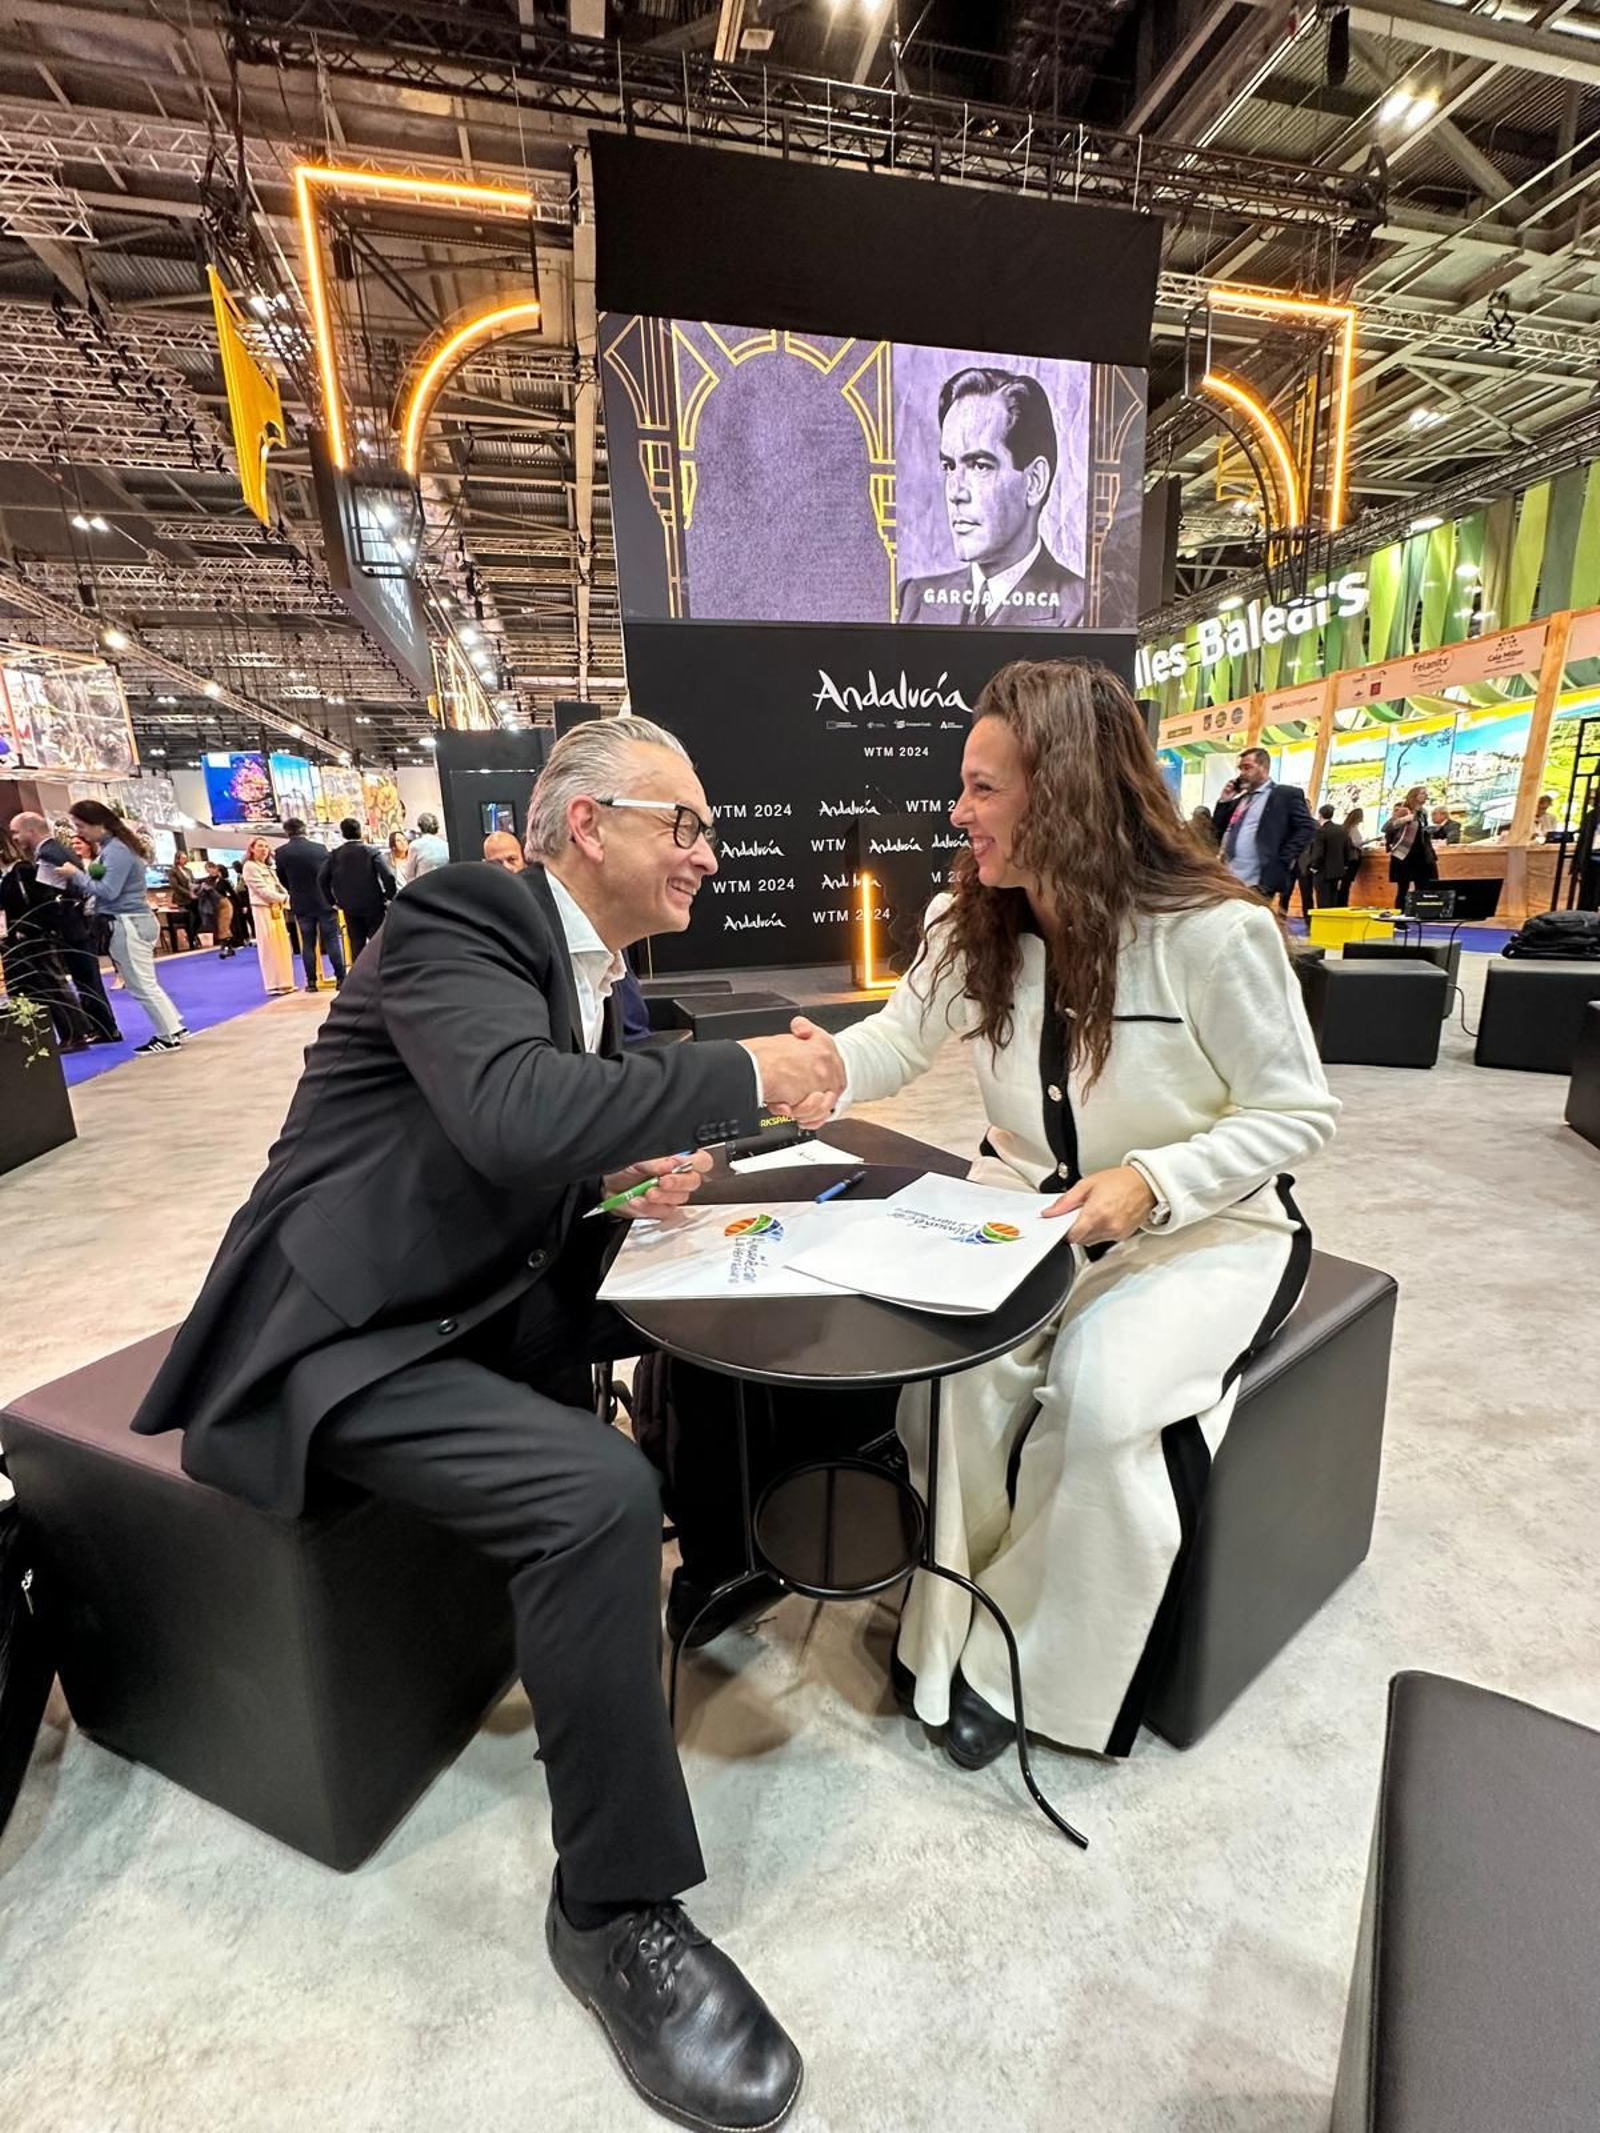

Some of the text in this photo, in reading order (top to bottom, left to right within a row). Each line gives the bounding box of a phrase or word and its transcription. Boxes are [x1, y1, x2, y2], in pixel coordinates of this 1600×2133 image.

[1197, 571, 1370, 667] Balears
[812, 669, 973, 713] Andalucía
[864, 746, 929, 757] WTM 2024
[711, 803, 792, 818] WTM 2024
[819, 800, 881, 816] Andalucía
[905, 800, 941, 812] WTM
[720, 840, 785, 858] Andalucía
[869, 837, 923, 854] Andalucía
[713, 878, 795, 893] WTM 2024
[723, 913, 787, 931] Andalucía
[812, 908, 890, 924] WTM 224
